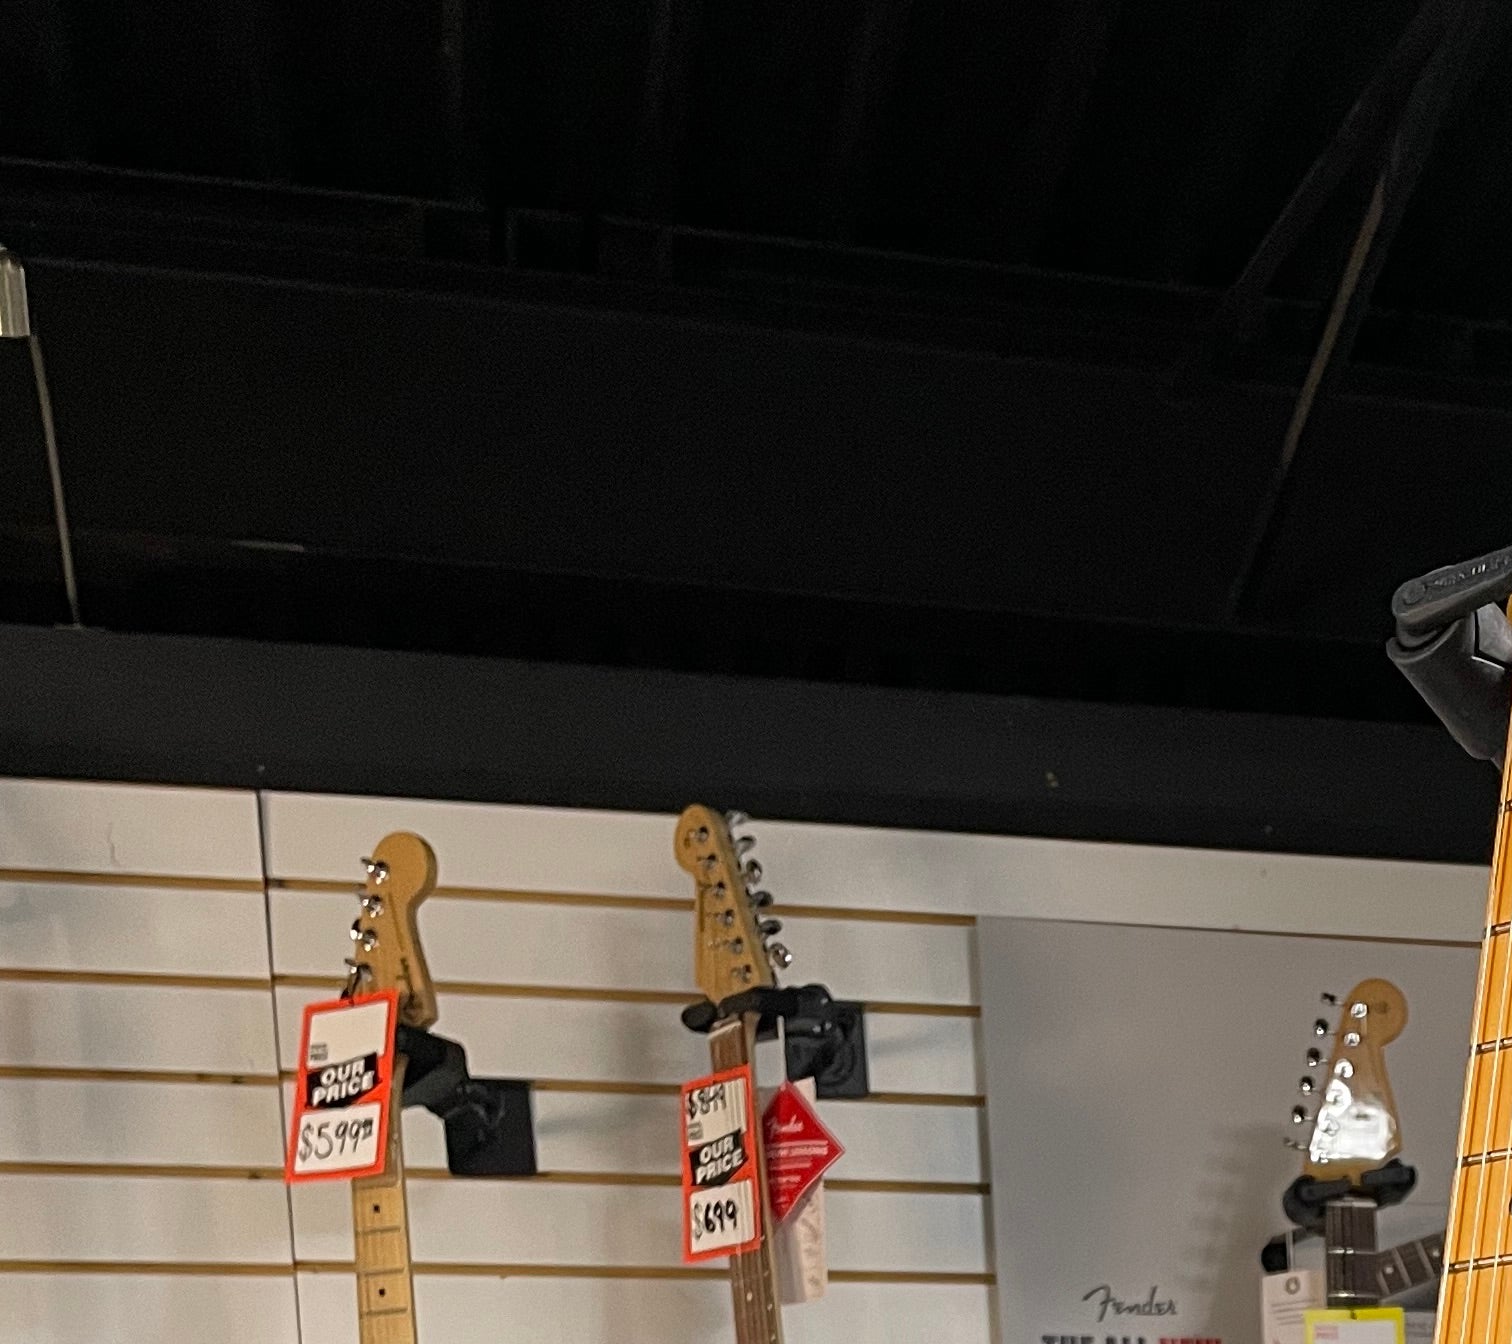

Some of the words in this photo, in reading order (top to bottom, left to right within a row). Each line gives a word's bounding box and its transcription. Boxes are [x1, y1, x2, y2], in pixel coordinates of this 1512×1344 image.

[312, 1070, 376, 1107] PRICE
[321, 1059, 366, 1086] OUR
[695, 1147, 744, 1185] PRICE
[701, 1135, 735, 1164] OUR
[692, 1199, 738, 1241] $699
[1082, 1285, 1178, 1323] Fender
